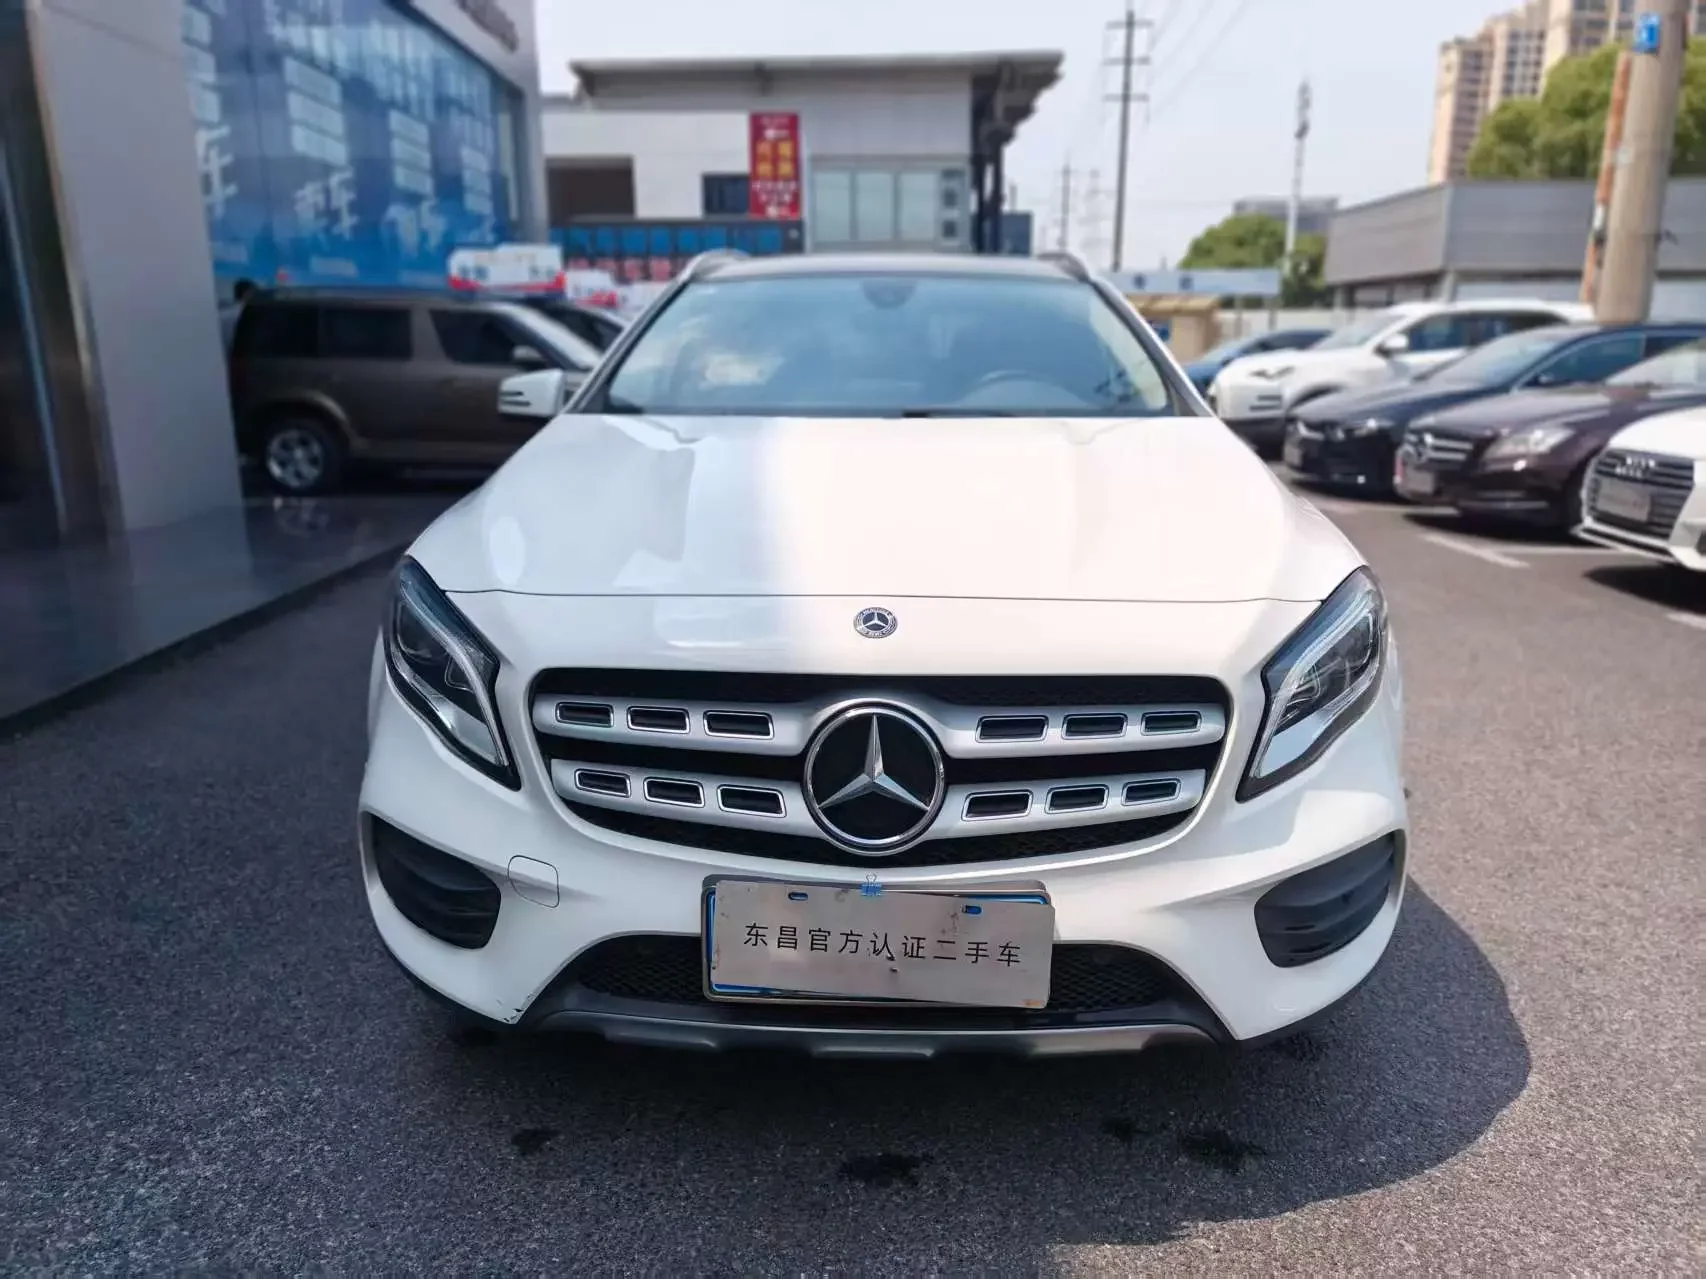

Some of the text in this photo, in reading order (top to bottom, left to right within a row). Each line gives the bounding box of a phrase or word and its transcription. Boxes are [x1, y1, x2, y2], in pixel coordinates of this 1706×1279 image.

[743, 922, 1021, 967] 东昌官方认证二手车
